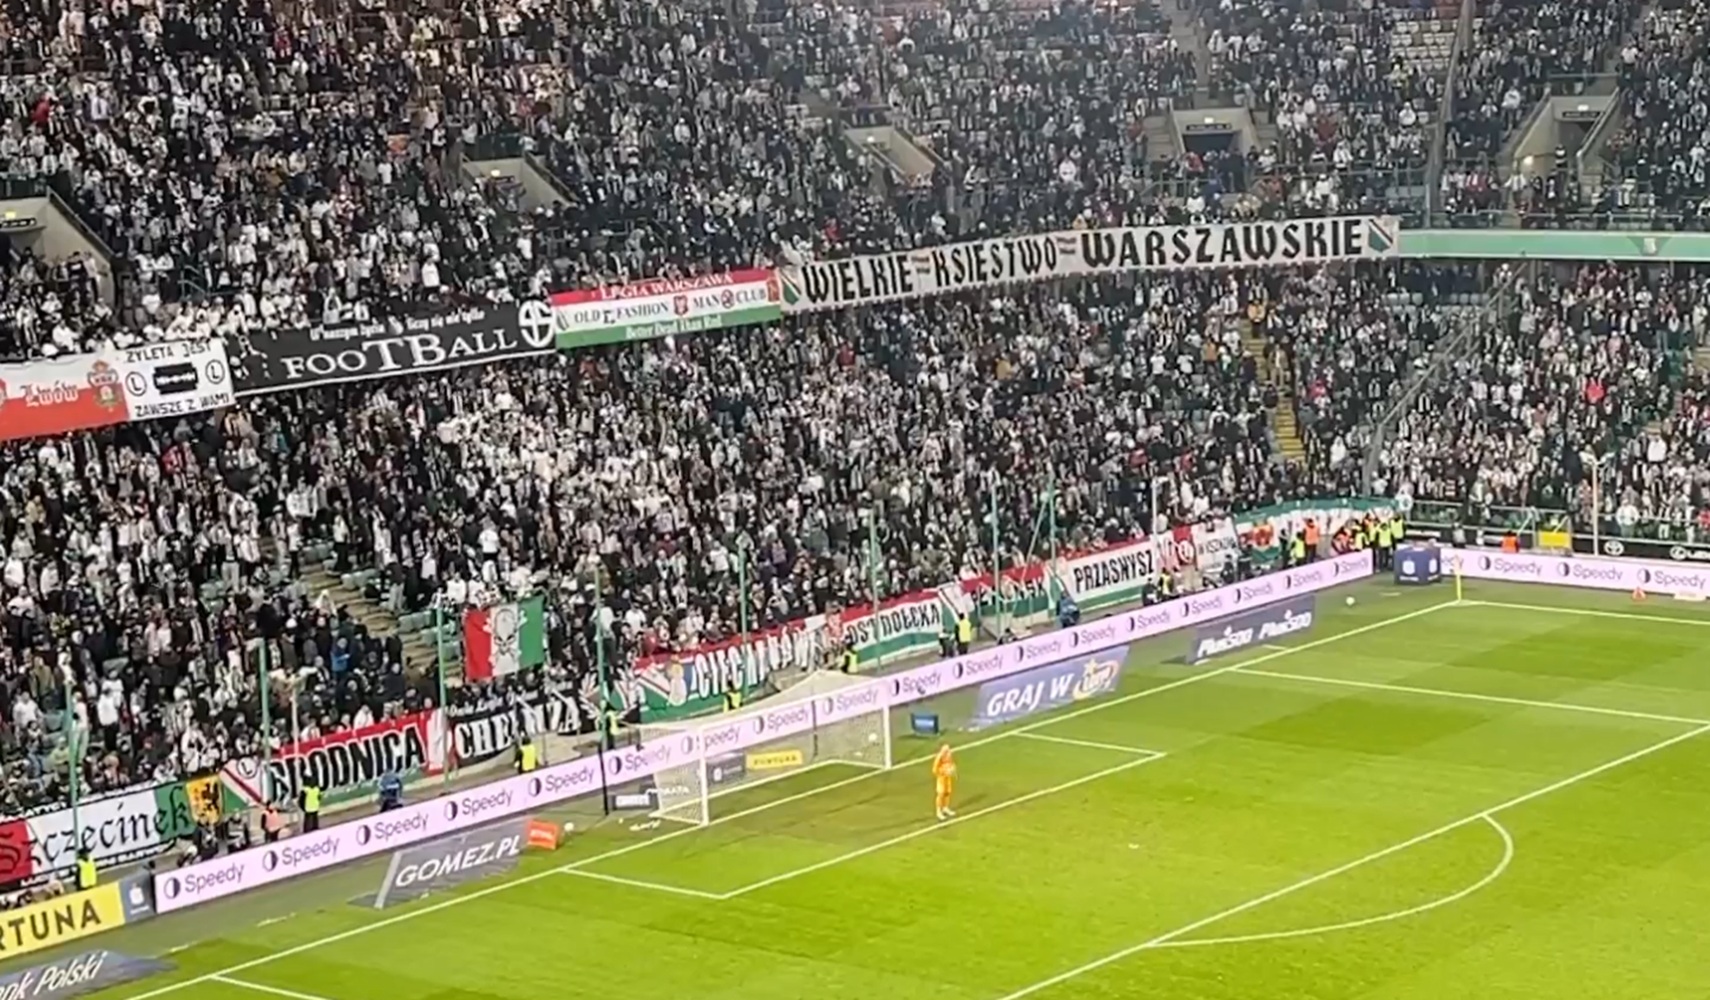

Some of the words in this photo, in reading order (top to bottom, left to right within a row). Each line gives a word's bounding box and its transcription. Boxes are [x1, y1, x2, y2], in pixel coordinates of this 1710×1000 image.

[801, 255, 913, 304] WIELKIE
[1081, 219, 1362, 268] WARSZAWSKIE
[601, 282, 648, 300] LEGIA
[574, 308, 602, 324] OLD
[616, 301, 669, 320] FASHION
[693, 294, 721, 308] MAN
[735, 288, 766, 303] CLUB
[281, 328, 518, 379] FOOTBALL
[134, 400, 184, 418] ZAWSZE
[187, 397, 197, 412] Z
[1073, 549, 1155, 594] PRZASNYSZ
[1494, 558, 1542, 576] Speedy
[1573, 564, 1623, 582] Speedy
[1654, 570, 1707, 590] Speedy
[1191, 595, 1223, 615] Speedy
[1136, 608, 1170, 630] Speedy
[1080, 624, 1116, 645] Speedy
[1025, 638, 1062, 659] Speedy
[965, 654, 1003, 676] Speedy
[902, 671, 941, 691] Speedy
[987, 679, 1044, 716] GRAJ
[1049, 674, 1074, 699] W
[767, 708, 810, 731] Speedy
[544, 767, 595, 793] Speedy
[461, 789, 513, 816] Speedy
[374, 813, 429, 840] Speedy
[281, 836, 341, 867] Speedy
[396, 835, 520, 887] GOMEZ.PL
[184, 862, 244, 894] Speedy
[0, 899, 101, 949] TUNA
[33, 952, 107, 995] Polski
